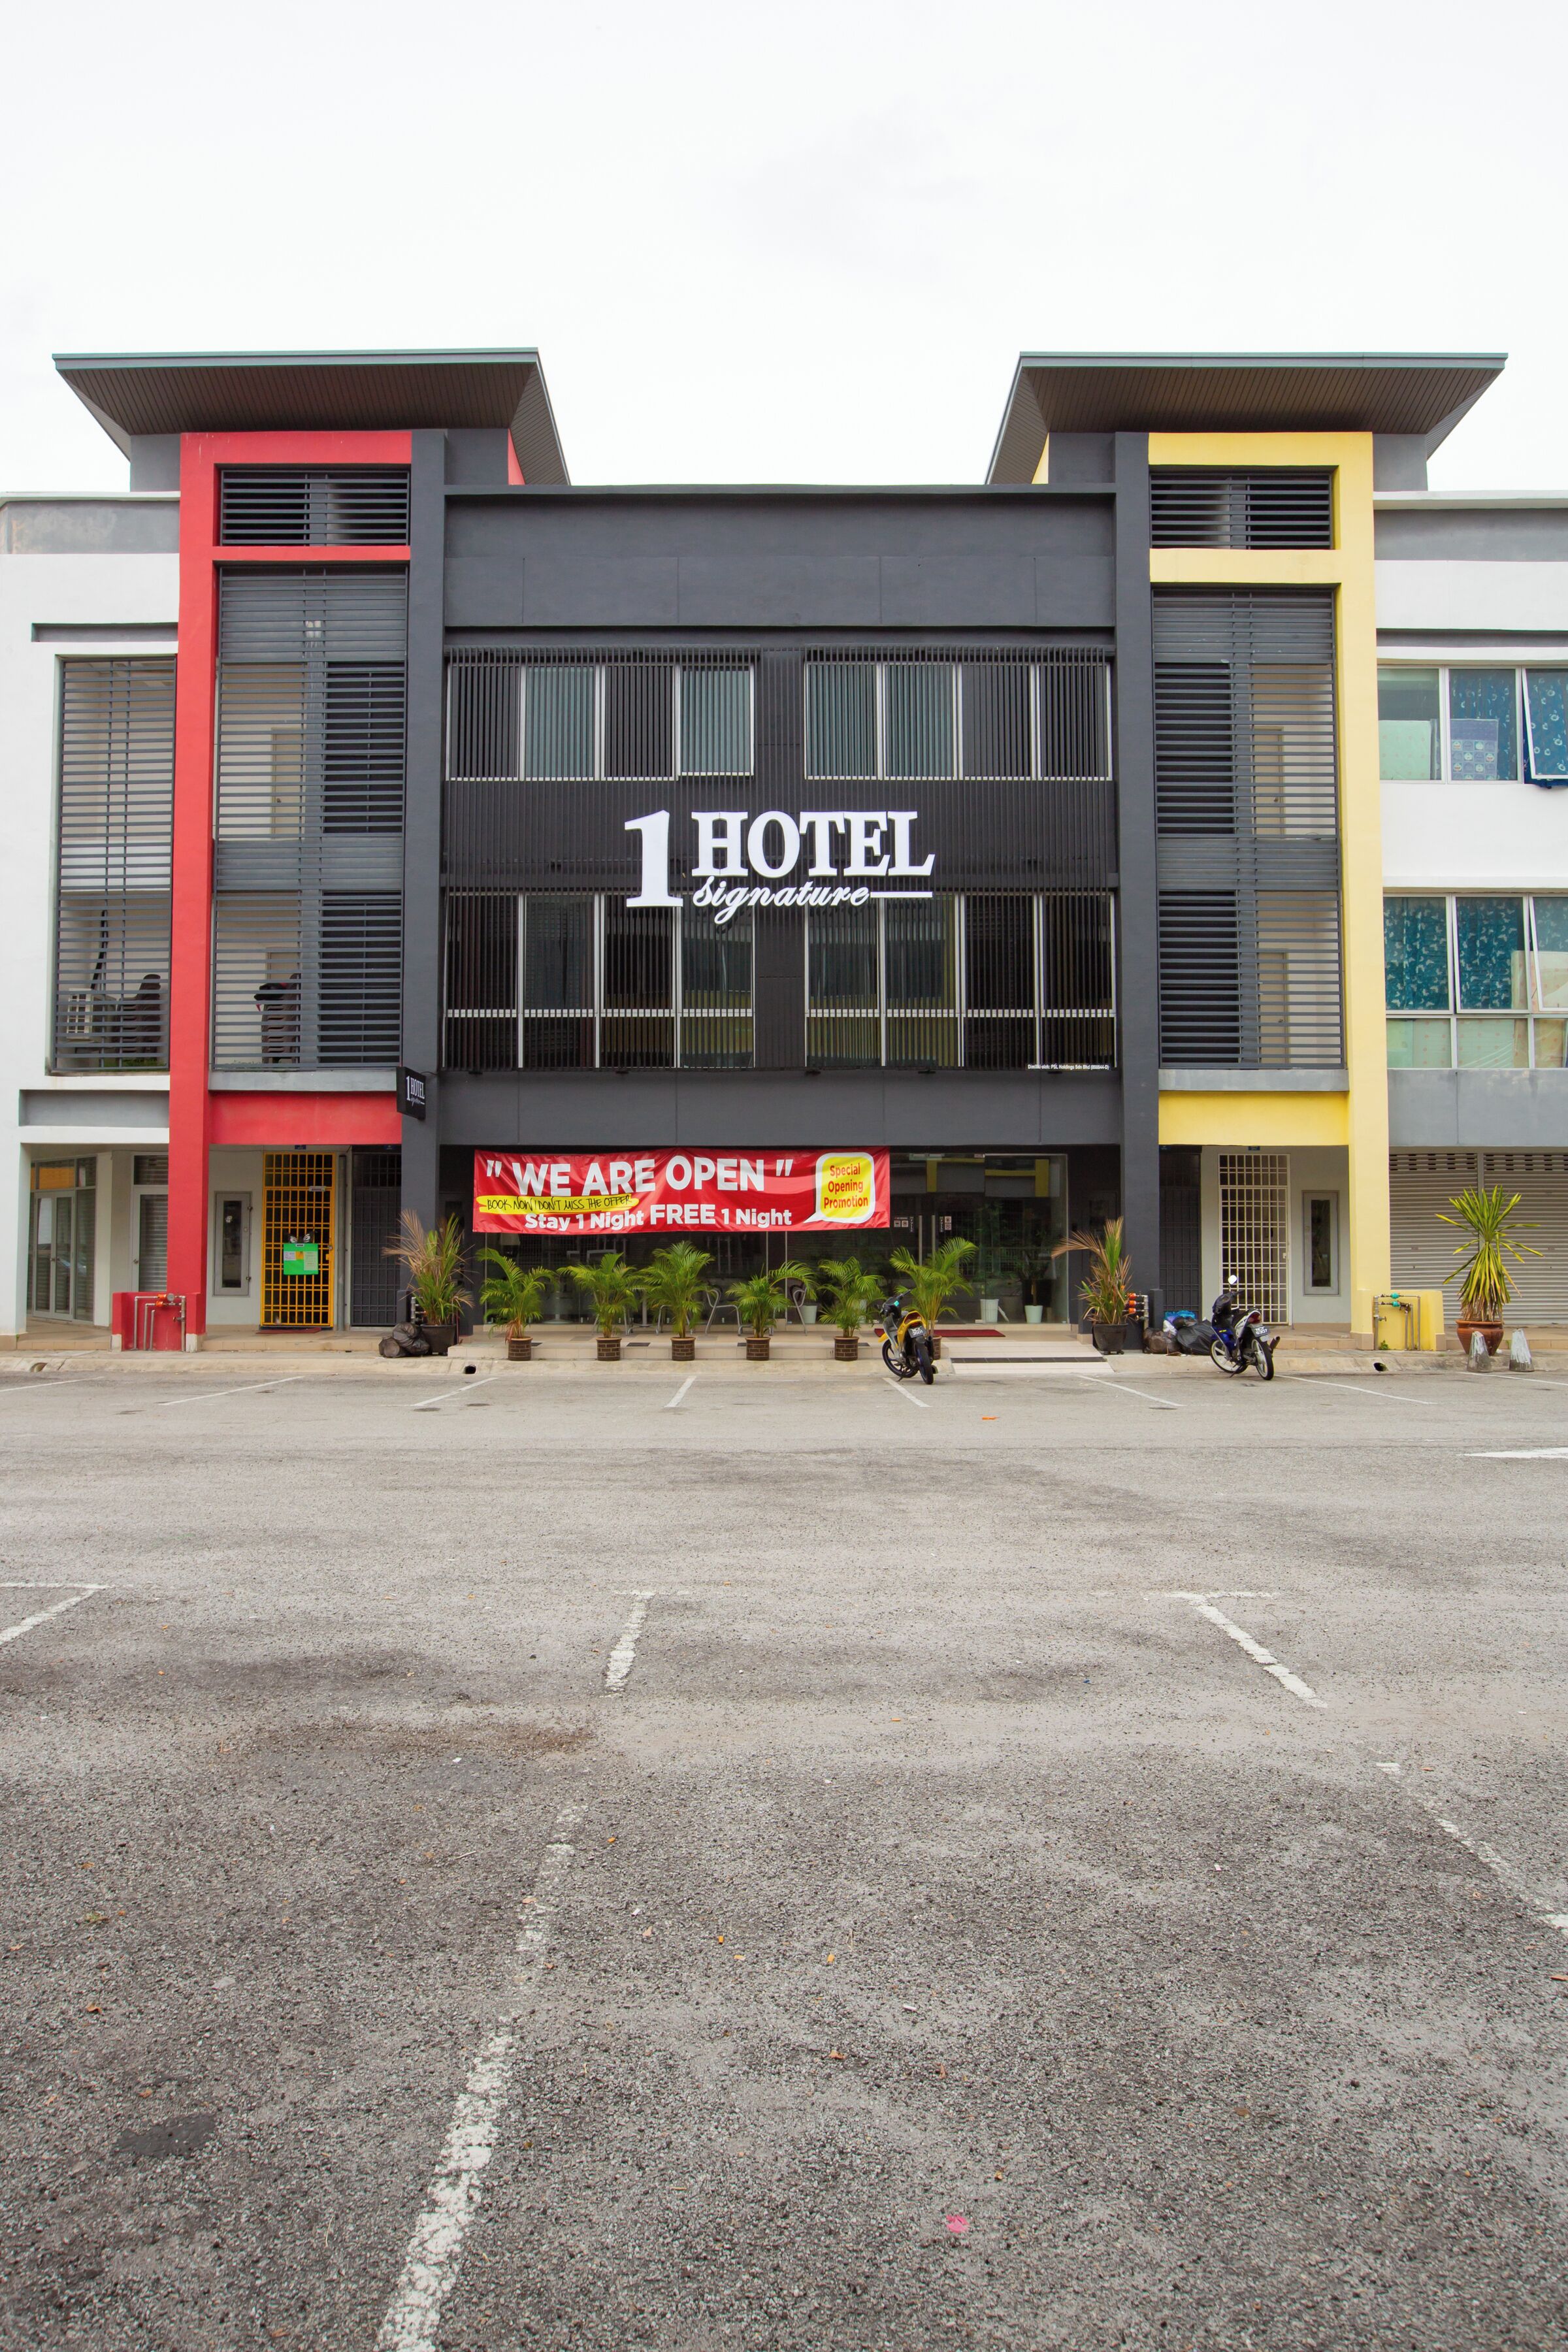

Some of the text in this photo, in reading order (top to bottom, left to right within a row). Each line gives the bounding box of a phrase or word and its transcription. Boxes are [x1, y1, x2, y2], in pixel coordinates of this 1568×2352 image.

[625, 809, 936, 907] 1 HOTEL
[406, 1075, 425, 1101] 1 HOTEL
[512, 1162, 571, 1196] WE
[581, 1159, 655, 1196] ARE
[665, 1155, 764, 1191] OPEN
[830, 1163, 860, 1177] Special
[828, 1179, 863, 1194] Opening
[487, 1198, 512, 1211] BOOK
[564, 1200, 584, 1211] MISS
[587, 1198, 602, 1209] THE
[604, 1194, 632, 1207] OFFER
[824, 1196, 868, 1209] Promotion
[525, 1204, 792, 1231] Stay 1 Night FREE 1 Night
